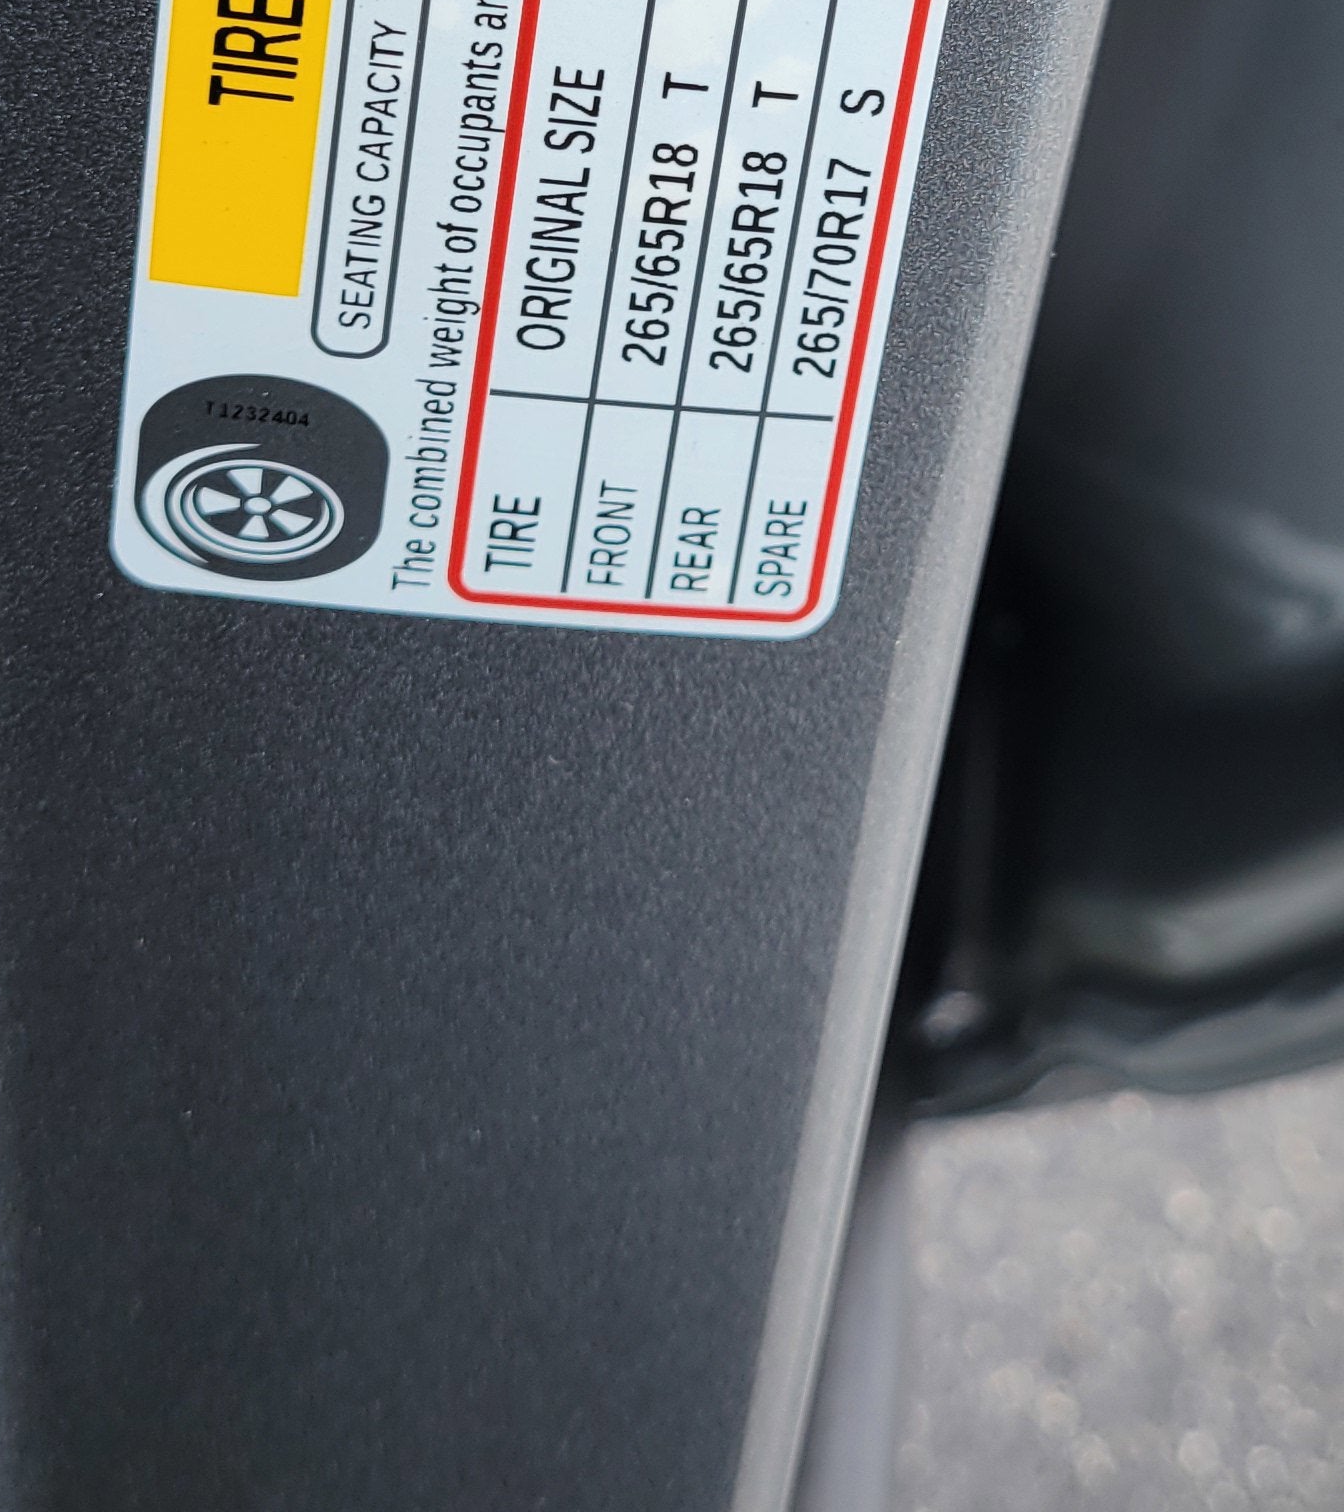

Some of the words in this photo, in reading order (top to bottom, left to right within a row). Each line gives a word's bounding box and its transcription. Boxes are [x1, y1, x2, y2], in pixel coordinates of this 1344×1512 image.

[355, 20, 407, 183] CAPACITY
[449, 41, 506, 214] occupants
[543, 65, 605, 155] SIZE
[337, 194, 386, 330] SEATING
[435, 221, 479, 254] of
[515, 167, 591, 351] ORIGINAL
[621, 142, 699, 367] 265/65R18
[661, 71, 710, 100] T
[708, 151, 788, 374] 265/65R18
[751, 80, 799, 108] T
[792, 158, 872, 379] 265/70R17
[839, 89, 885, 117] S
[426, 262, 481, 368] weight
[205, 400, 309, 427] T1232404
[405, 378, 458, 529] combined
[391, 538, 437, 591] The
[483, 493, 542, 573] TIRE
[586, 479, 637, 586] FRONT
[669, 507, 721, 592] REAR
[753, 500, 808, 597] SPARE
